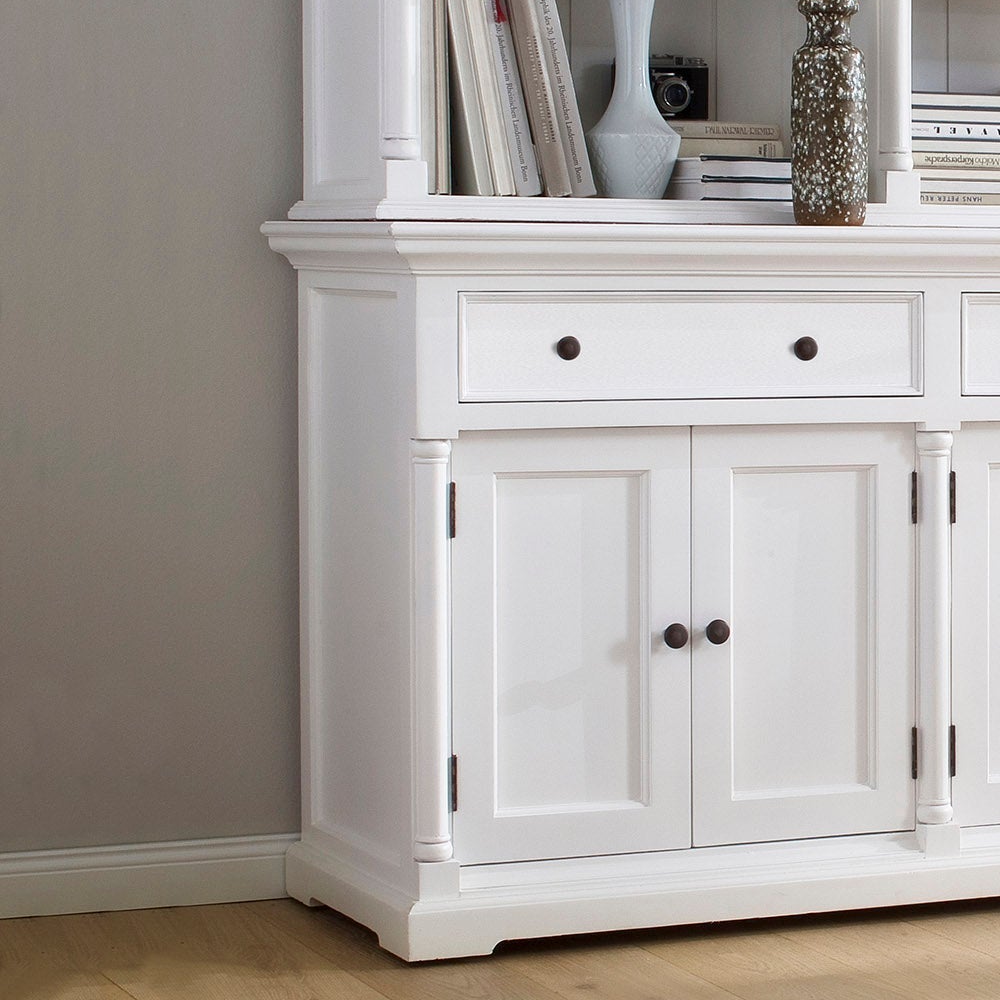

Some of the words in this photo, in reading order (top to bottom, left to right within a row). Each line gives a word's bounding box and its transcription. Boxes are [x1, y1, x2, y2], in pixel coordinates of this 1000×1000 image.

[495, 35, 508, 73] Jahrhunderts
[548, 36, 562, 76] Jahrhunderts
[504, 73, 510, 83] im
[556, 76, 563, 85] im
[505, 82, 517, 119] Rheinischen
[558, 84, 570, 122] Rheinischen
[513, 119, 525, 164] Landesmuseum
[565, 122, 579, 168] Landesmuseum
[575, 167, 583, 184] Bonn
[925, 155, 975, 166] Körpersprache
